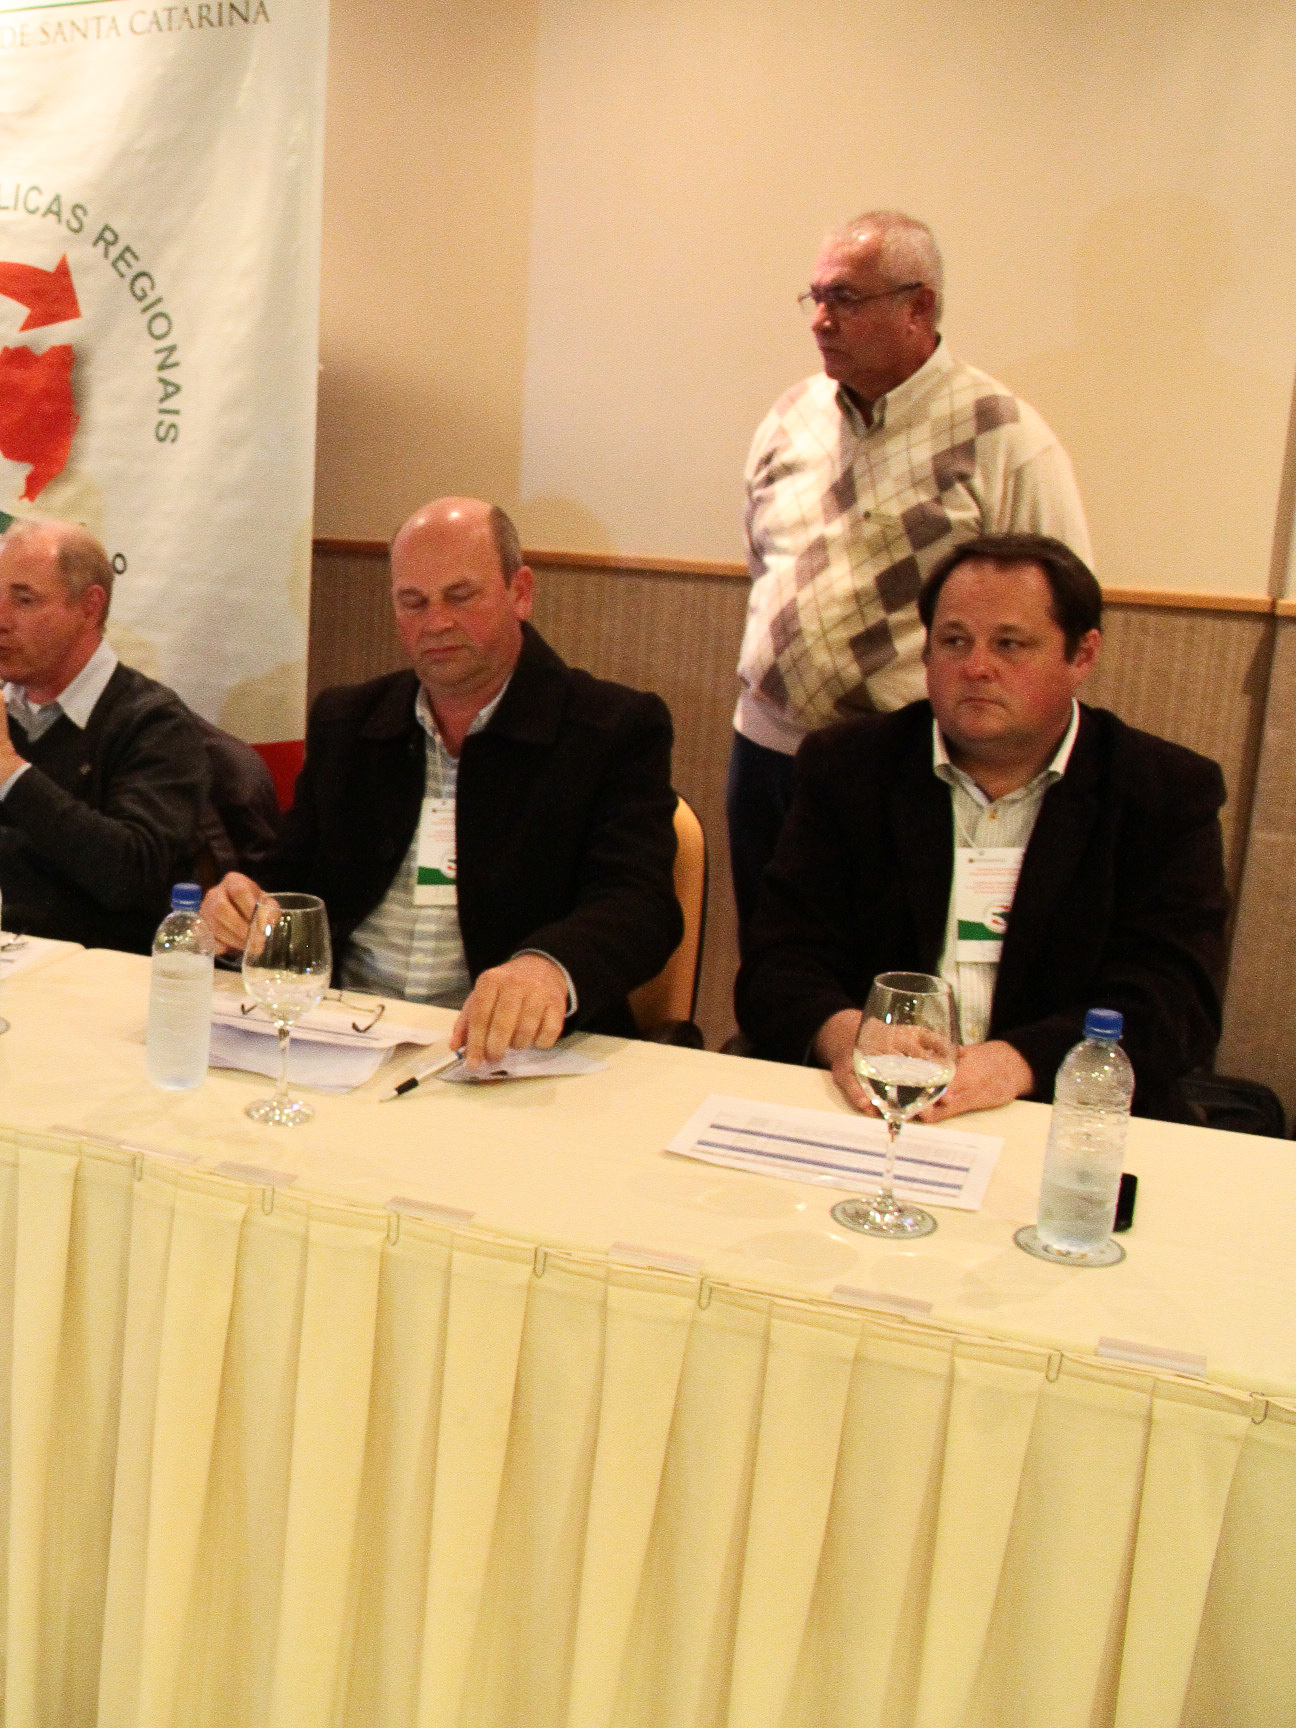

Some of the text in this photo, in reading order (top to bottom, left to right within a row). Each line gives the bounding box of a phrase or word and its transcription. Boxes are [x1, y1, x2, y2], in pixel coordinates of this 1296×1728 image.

[0, 24, 31, 50] DE
[38, 15, 121, 46] SANTA
[129, 0, 271, 36] CATARINA
[92, 223, 182, 444] REGIONAIS
